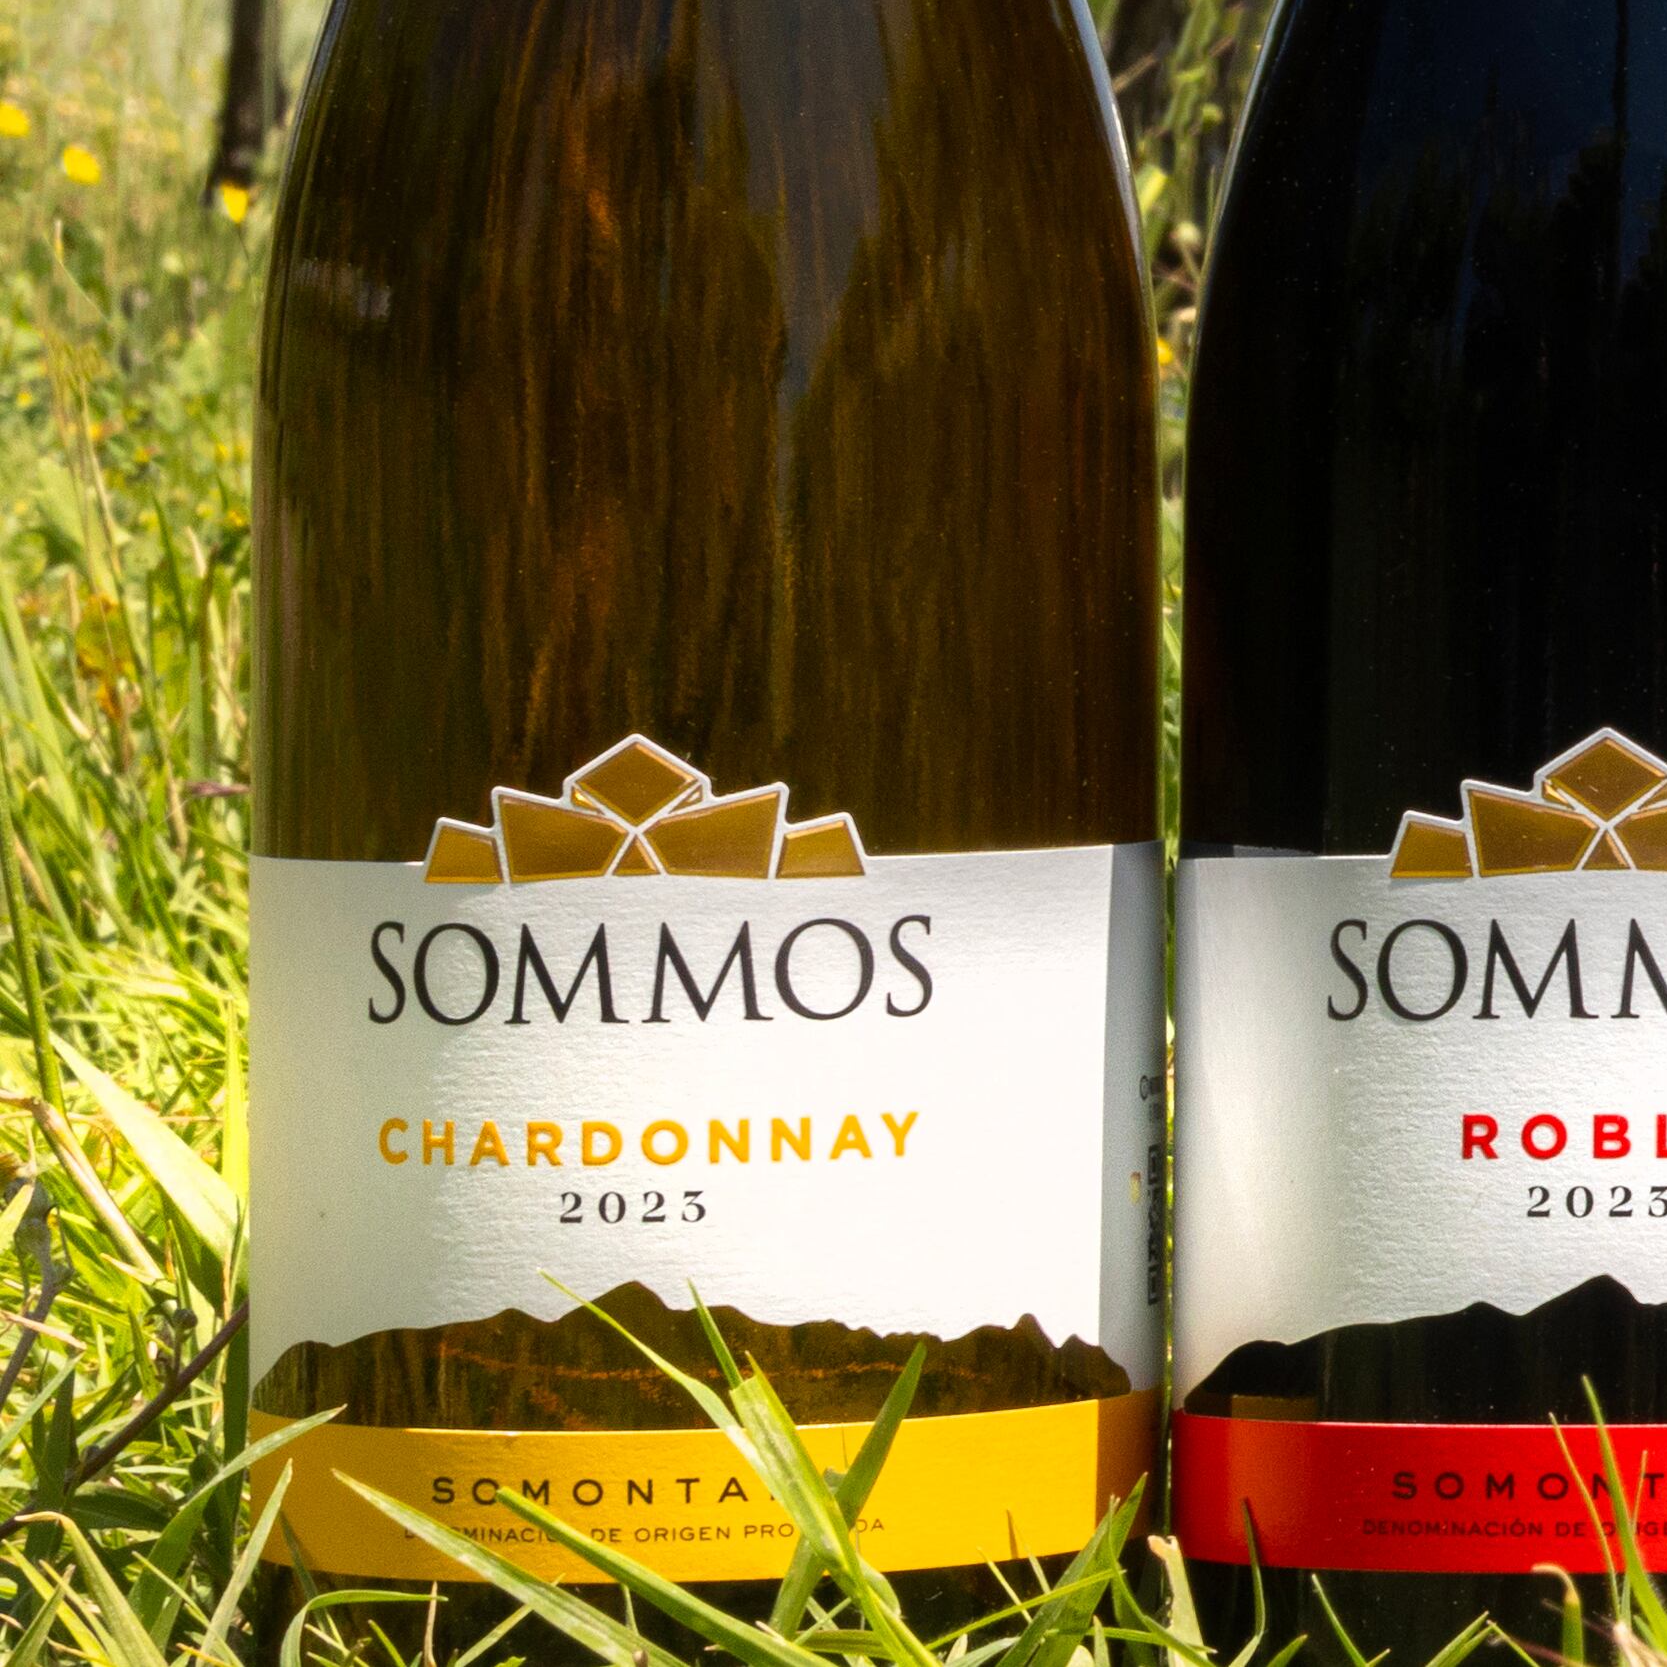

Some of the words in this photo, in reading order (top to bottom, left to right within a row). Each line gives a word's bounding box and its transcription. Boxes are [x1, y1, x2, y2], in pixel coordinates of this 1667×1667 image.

[368, 915, 933, 1026] SOMMOS
[378, 1111, 919, 1167] CHARDONNAY
[558, 1190, 708, 1224] 2023
[431, 1476, 776, 1506] SOMONTA
[634, 1526, 730, 1543] ORIGEN
[1555, 1521, 1586, 1537] DE
